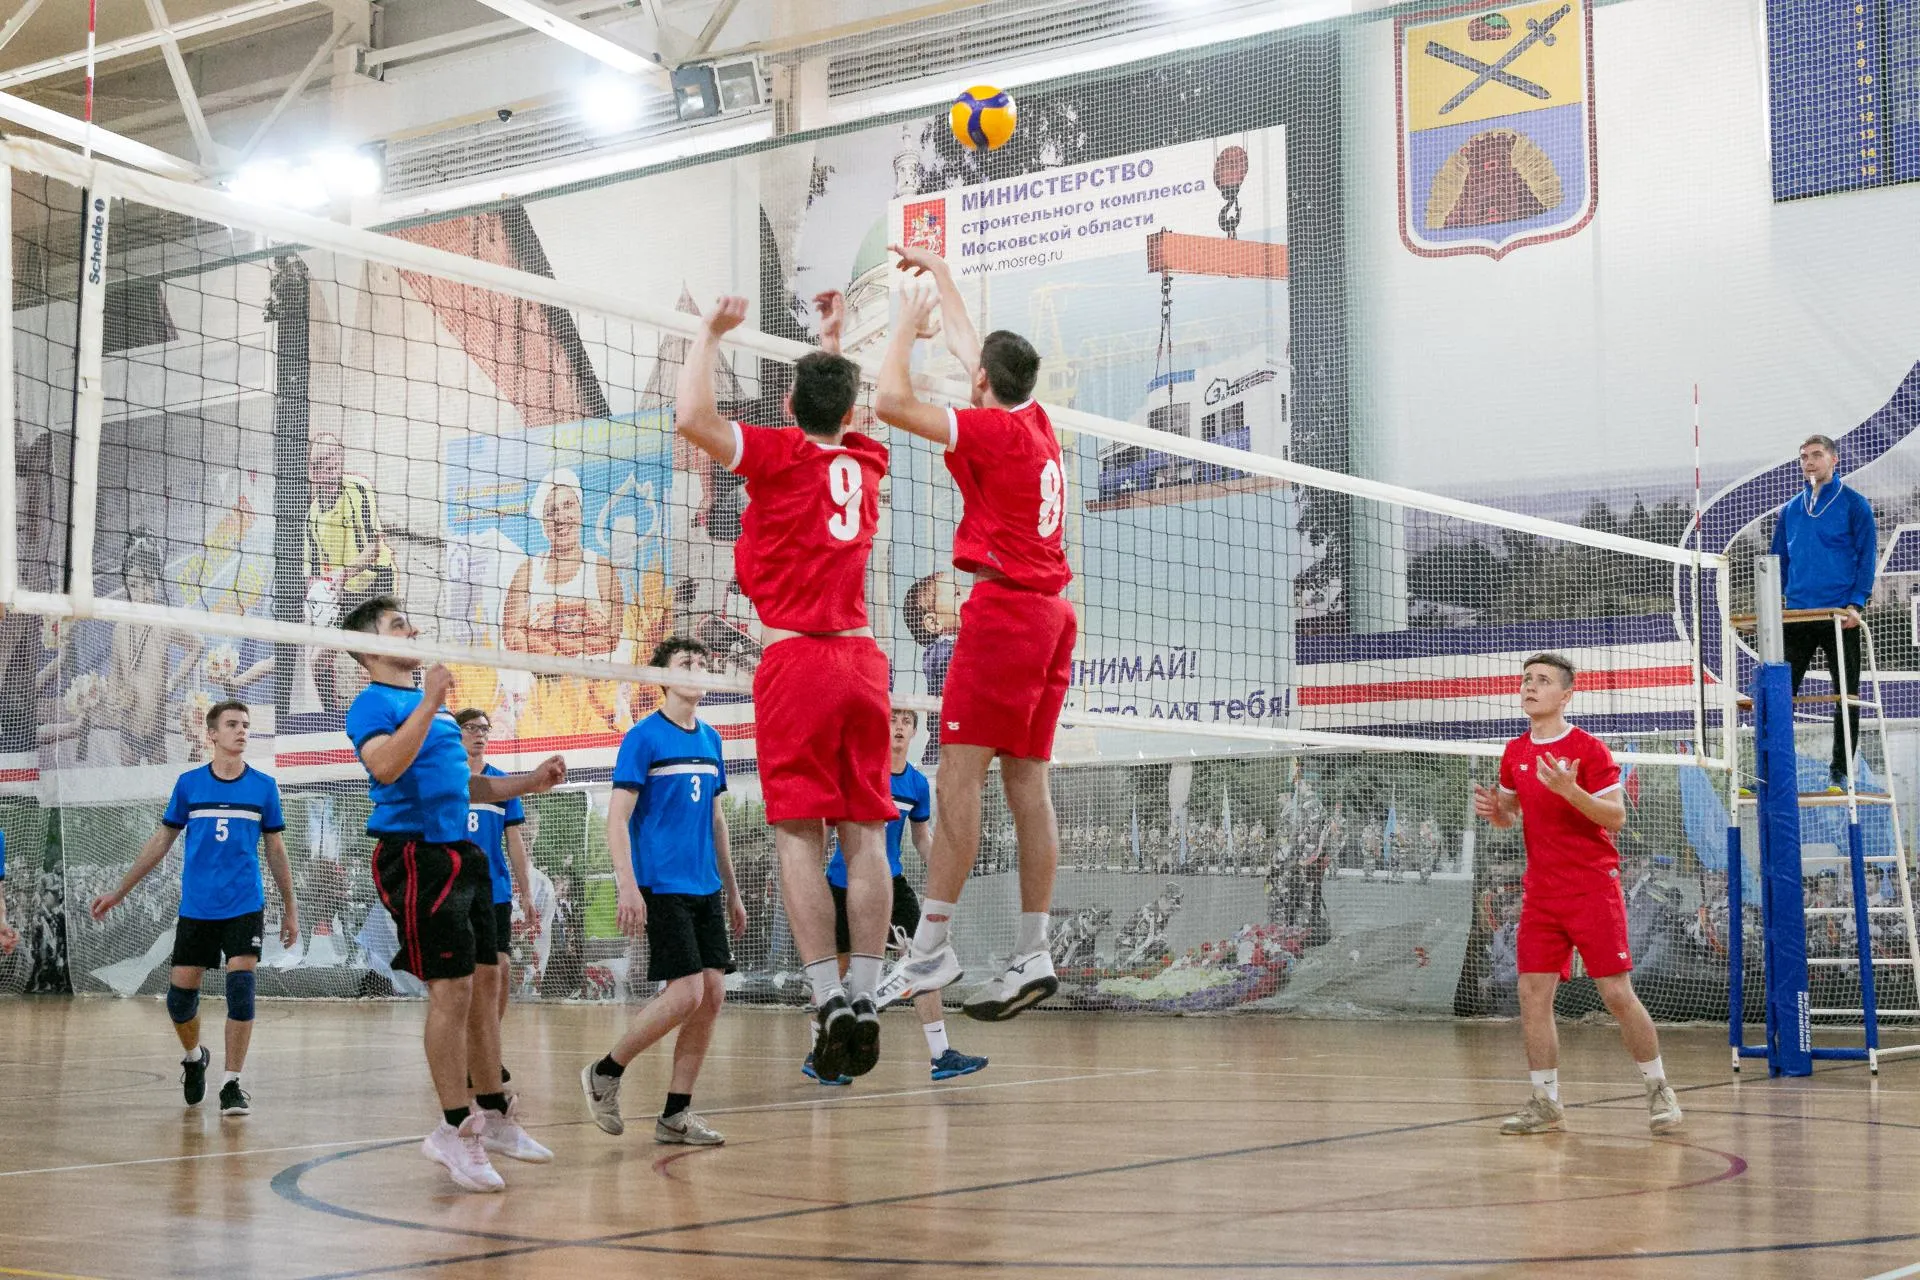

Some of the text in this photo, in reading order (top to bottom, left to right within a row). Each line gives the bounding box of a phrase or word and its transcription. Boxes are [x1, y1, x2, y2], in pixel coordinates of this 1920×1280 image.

[1858, 75, 1873, 86] 10
[1859, 93, 1873, 105] 11
[1860, 112, 1874, 123] 12
[961, 159, 1154, 212] МИНИСТЕРСТВО
[1861, 165, 1876, 177] 15
[961, 179, 1207, 236] строительного комплекса
[88, 215, 104, 285] Schelde
[961, 213, 1155, 257] Московской области
[961, 249, 1064, 276] www.mosreg.ru
[828, 454, 863, 541] 9
[1070, 645, 1197, 688] НИМАЙ!
[1208, 688, 1291, 721] тебя!
[690, 775, 701, 802] 3
[215, 818, 230, 842] 5
[467, 811, 479, 832] 8
[1797, 991, 1806, 1052] International
